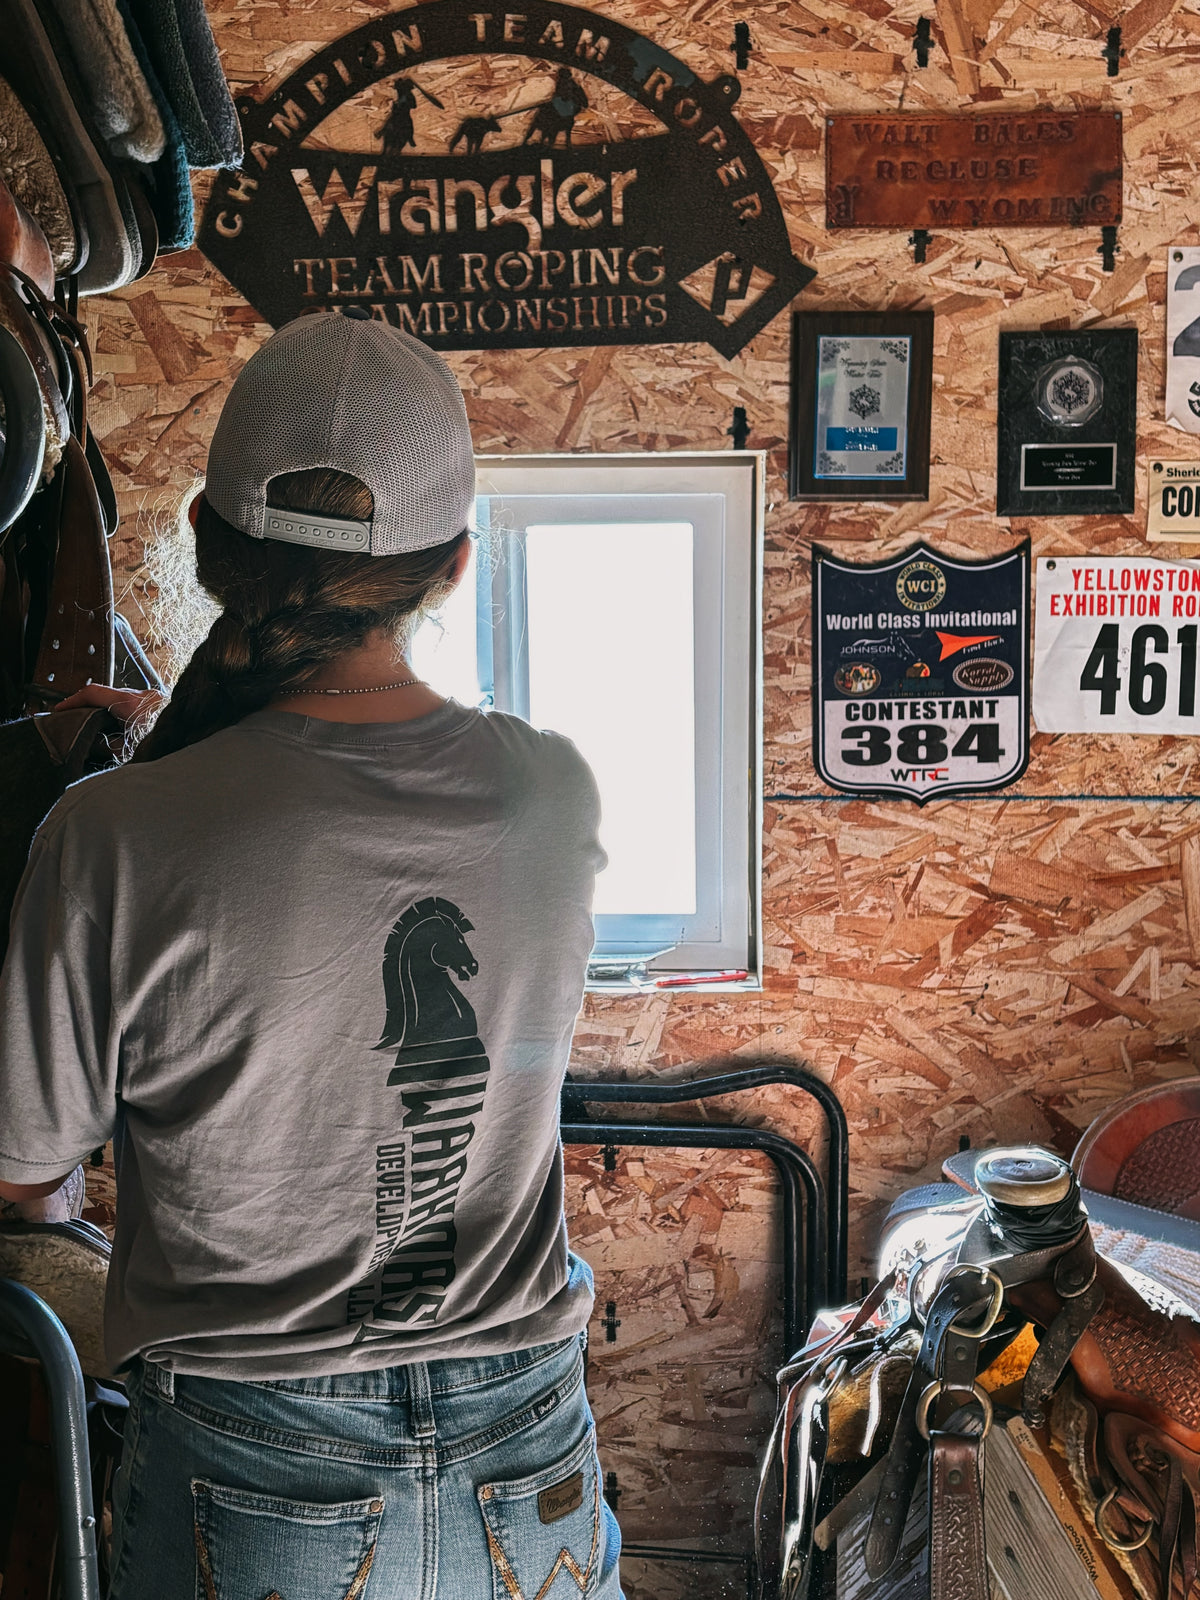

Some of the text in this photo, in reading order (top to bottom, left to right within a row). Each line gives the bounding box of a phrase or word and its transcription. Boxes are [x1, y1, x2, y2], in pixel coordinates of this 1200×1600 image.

[215, 13, 763, 239] CHAMPION TEAM ROPER
[851, 119, 1077, 146] WALT BALES
[290, 158, 638, 251] Wrangler
[927, 193, 1112, 220] WYOMING
[293, 246, 666, 298] TEAM ROPING
[300, 294, 668, 336] AMPIONSHIPS
[906, 580, 936, 593] WCI
[1050, 594, 1200, 617] EXHIBITION RO
[826, 609, 1017, 630] World Class Invitational
[840, 645, 896, 655] JOHNSON
[1080, 623, 1198, 717] 461
[845, 700, 999, 722] CONTESTANT
[840, 723, 1006, 766] 384
[891, 768, 949, 782] WTRC
[352, 1079, 487, 1343] WARHORS
